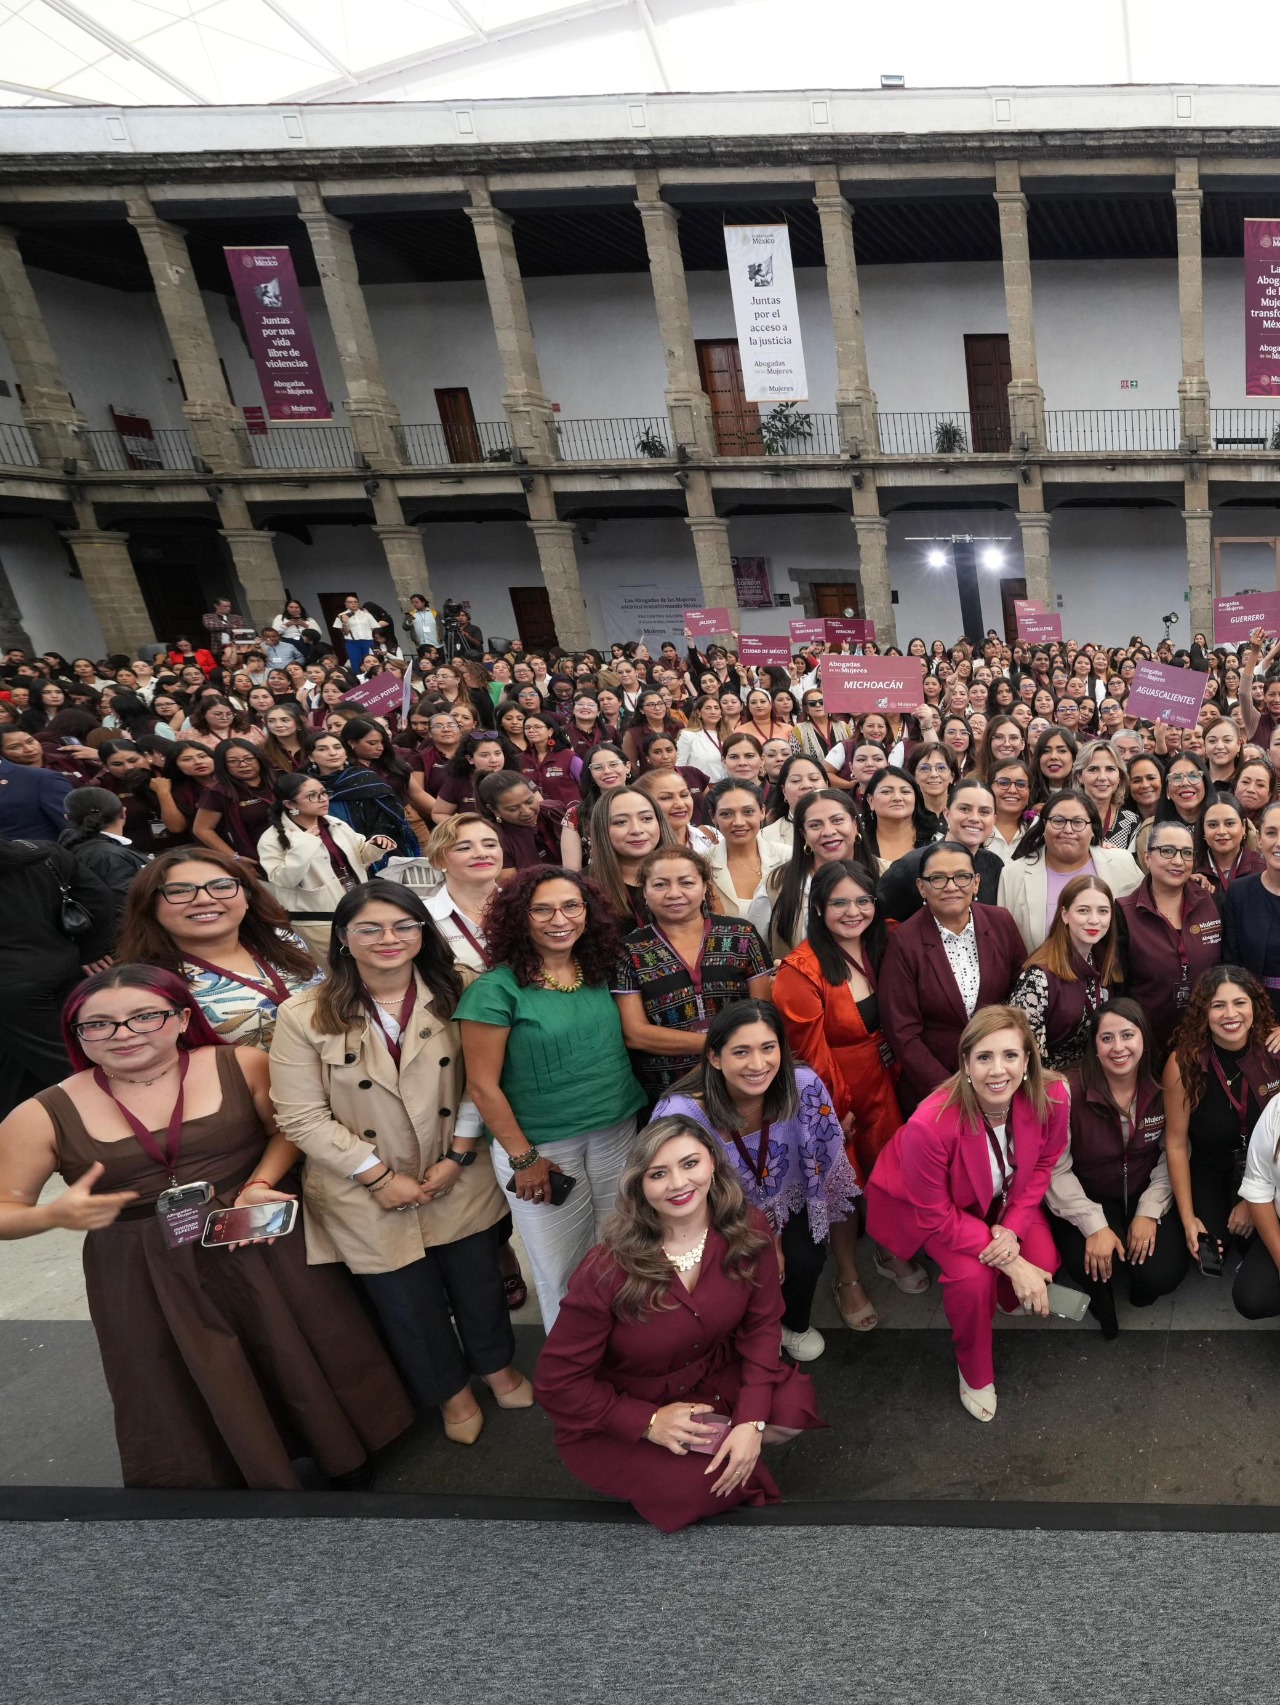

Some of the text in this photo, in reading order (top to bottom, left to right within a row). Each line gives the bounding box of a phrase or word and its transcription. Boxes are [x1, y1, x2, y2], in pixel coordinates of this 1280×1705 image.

[1266, 287, 1276, 295] de
[751, 296, 781, 305] Juntas
[754, 310, 780, 320] por el
[262, 316, 291, 325] Juntas
[262, 329, 278, 337] por
[272, 338, 290, 346] vida
[749, 336, 792, 347] la justicia
[268, 349, 288, 357] libre
[266, 359, 308, 368] violencias
[274, 380, 305, 388] Abogadas
[1230, 614, 1264, 624] GUERRERO
[1140, 666, 1162, 676] Abogadas
[1147, 674, 1165, 683] Mujeres
[844, 680, 903, 689] MICHOACÁN
[368, 696, 381, 705] LUIS
[380, 684, 400, 698] POTOSÍ
[1136, 686, 1195, 705] AGUASCALIENTES
[1199, 919, 1221, 928] Mujeres
[174, 1222, 198, 1232] INVITADA
[175, 1225, 199, 1236] ESPECIAL
